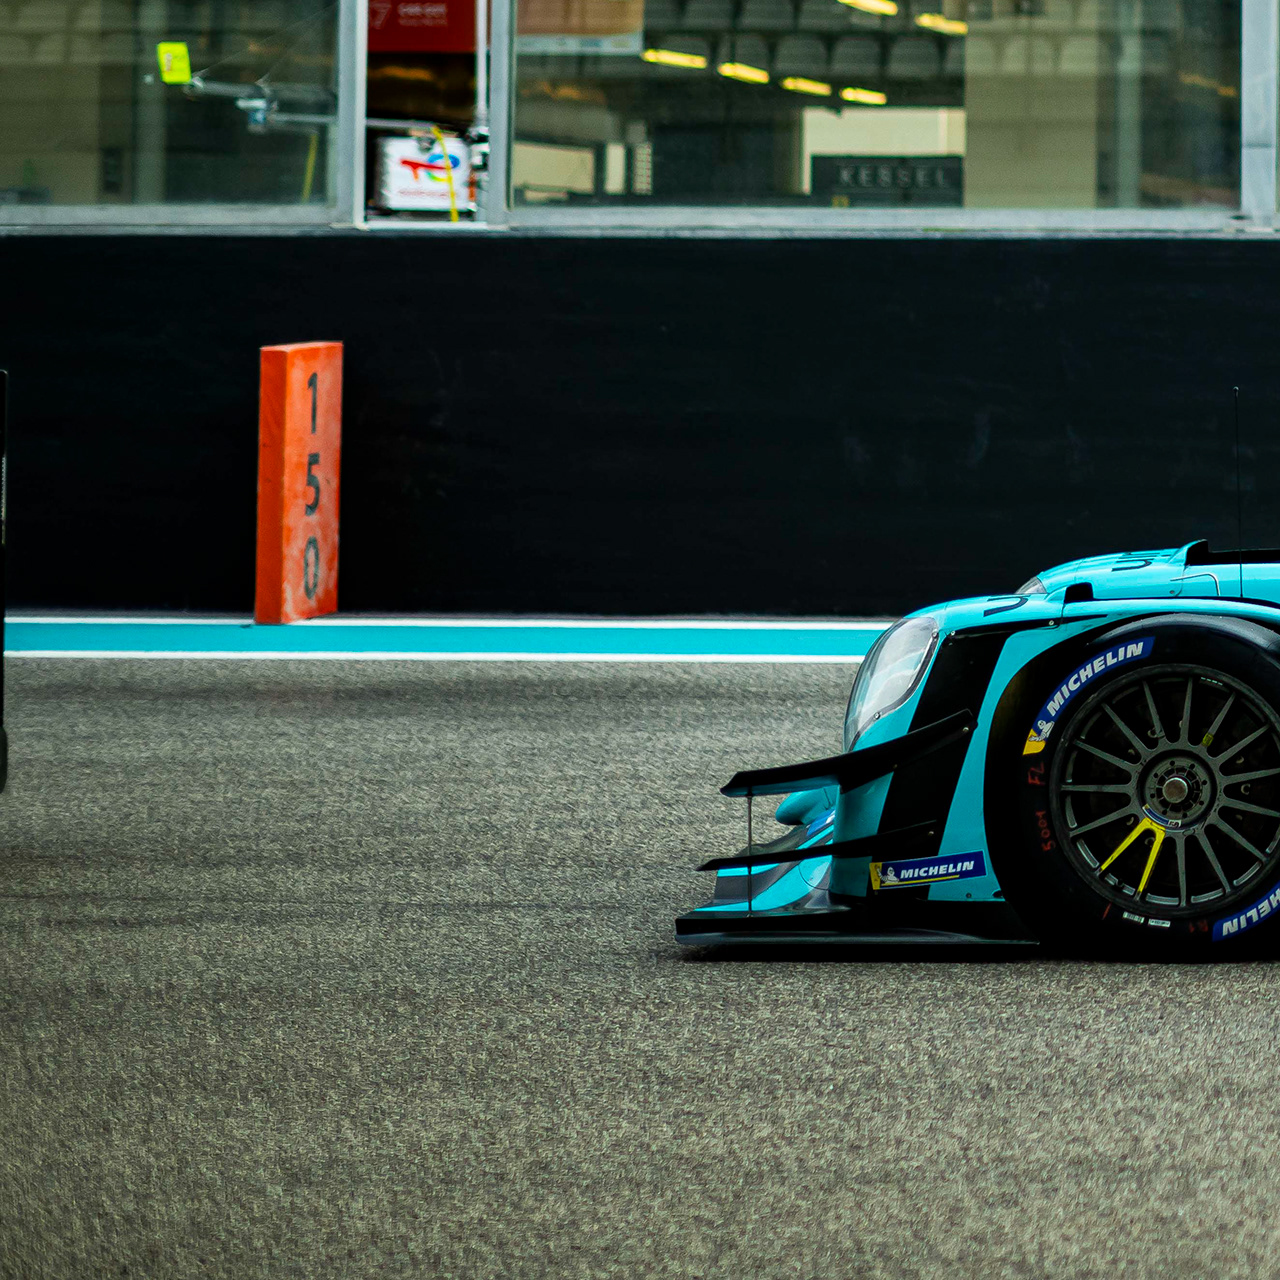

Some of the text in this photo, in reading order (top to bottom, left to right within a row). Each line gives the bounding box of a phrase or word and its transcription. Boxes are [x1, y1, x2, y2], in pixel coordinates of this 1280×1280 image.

[303, 371, 321, 600] 150
[1046, 640, 1145, 718] MICHELIN
[899, 860, 975, 879] MICHELIN
